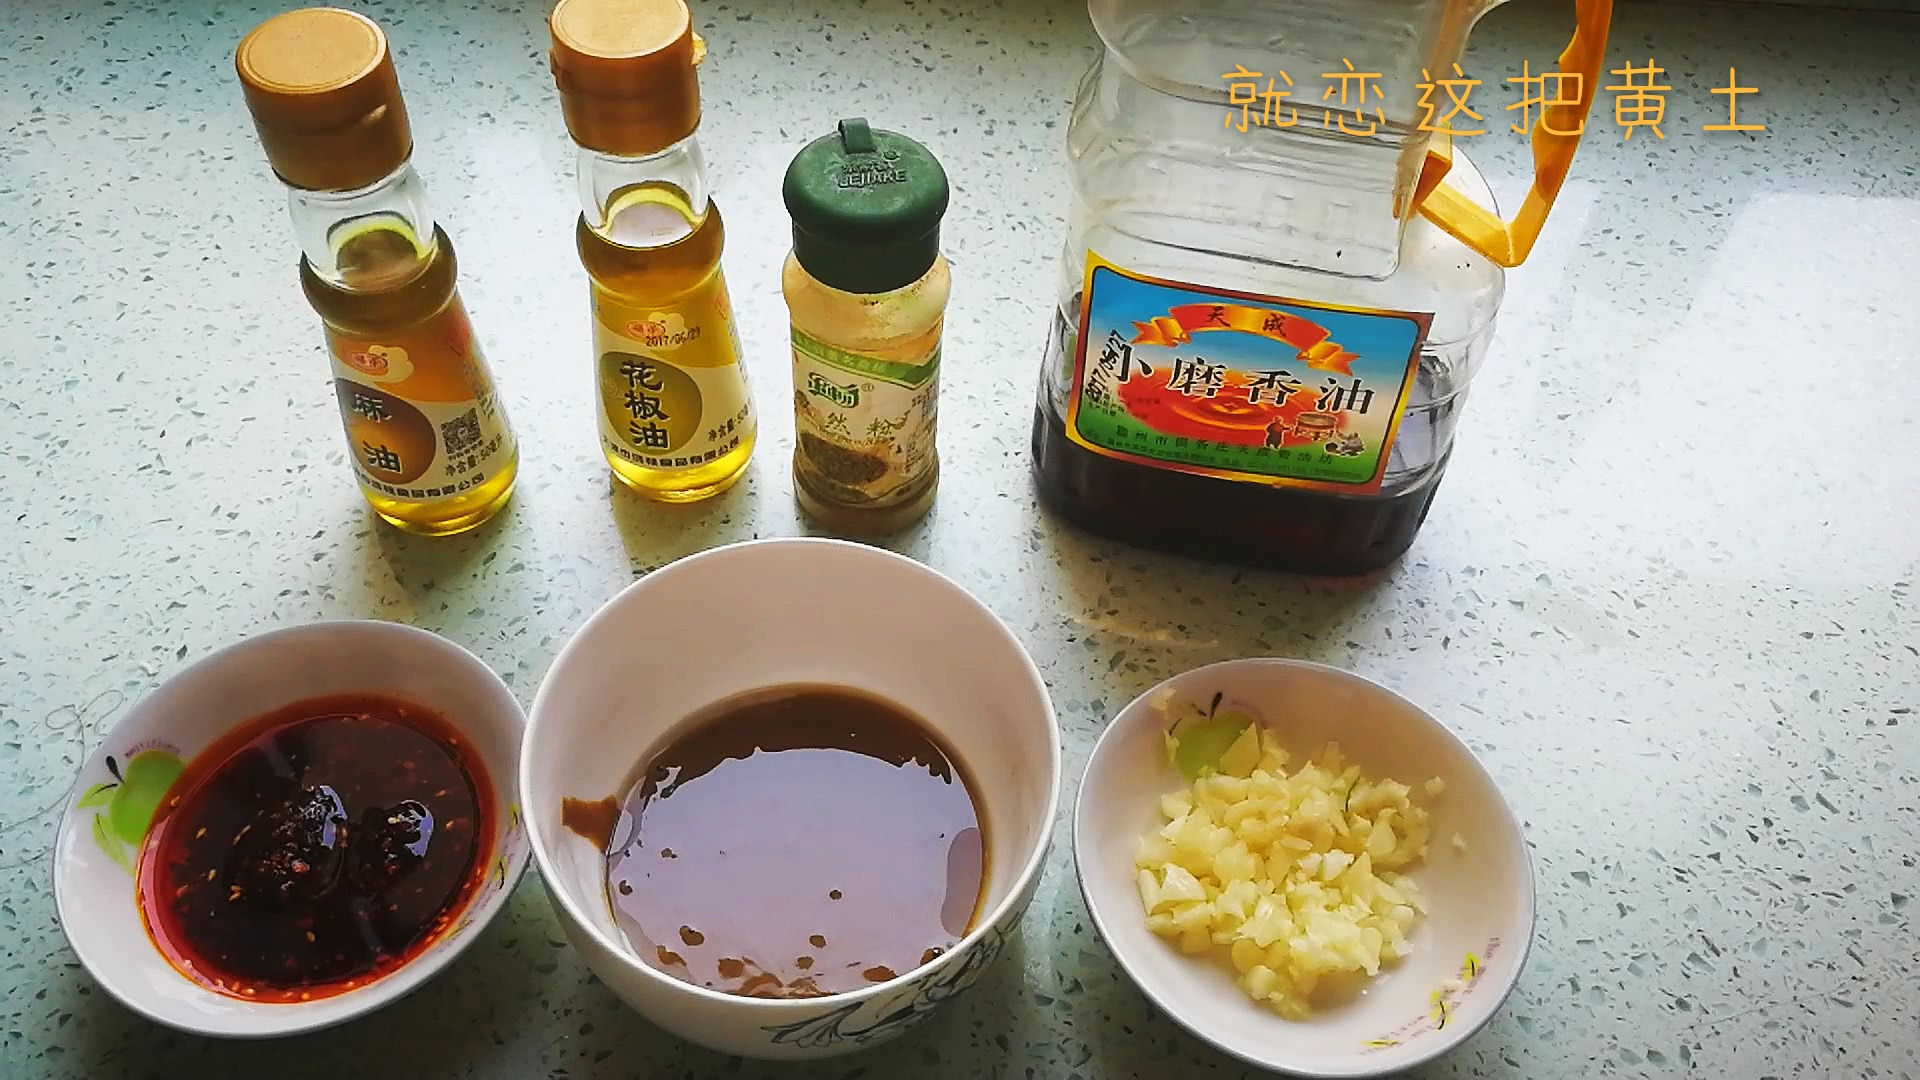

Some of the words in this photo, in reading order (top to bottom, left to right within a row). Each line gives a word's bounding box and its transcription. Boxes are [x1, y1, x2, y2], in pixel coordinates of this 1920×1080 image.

[619, 359, 671, 450] 花椒油
[1117, 344, 1374, 415] 小磨香油
